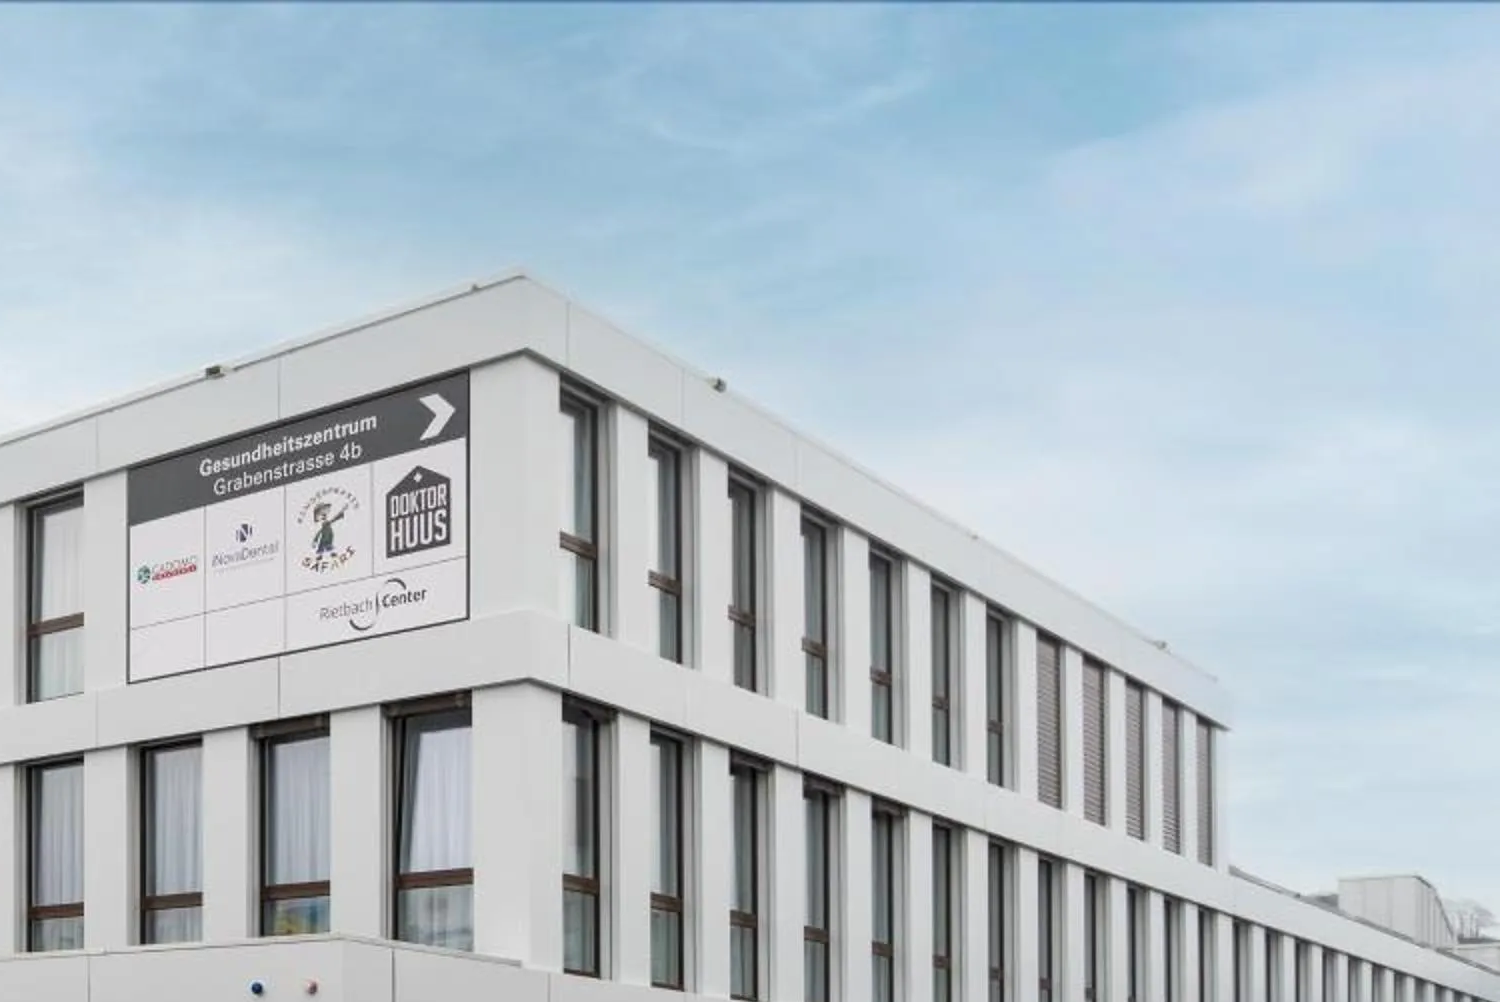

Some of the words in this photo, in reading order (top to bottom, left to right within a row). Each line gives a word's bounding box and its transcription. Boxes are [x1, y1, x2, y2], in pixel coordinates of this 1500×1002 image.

[199, 415, 377, 477] Gesundheitszentrum
[213, 450, 335, 496] Grabenstrasse
[339, 441, 363, 462] 4b
[390, 483, 447, 519] DOKTOR
[390, 508, 447, 552] HUUS
[382, 589, 428, 608] Center
